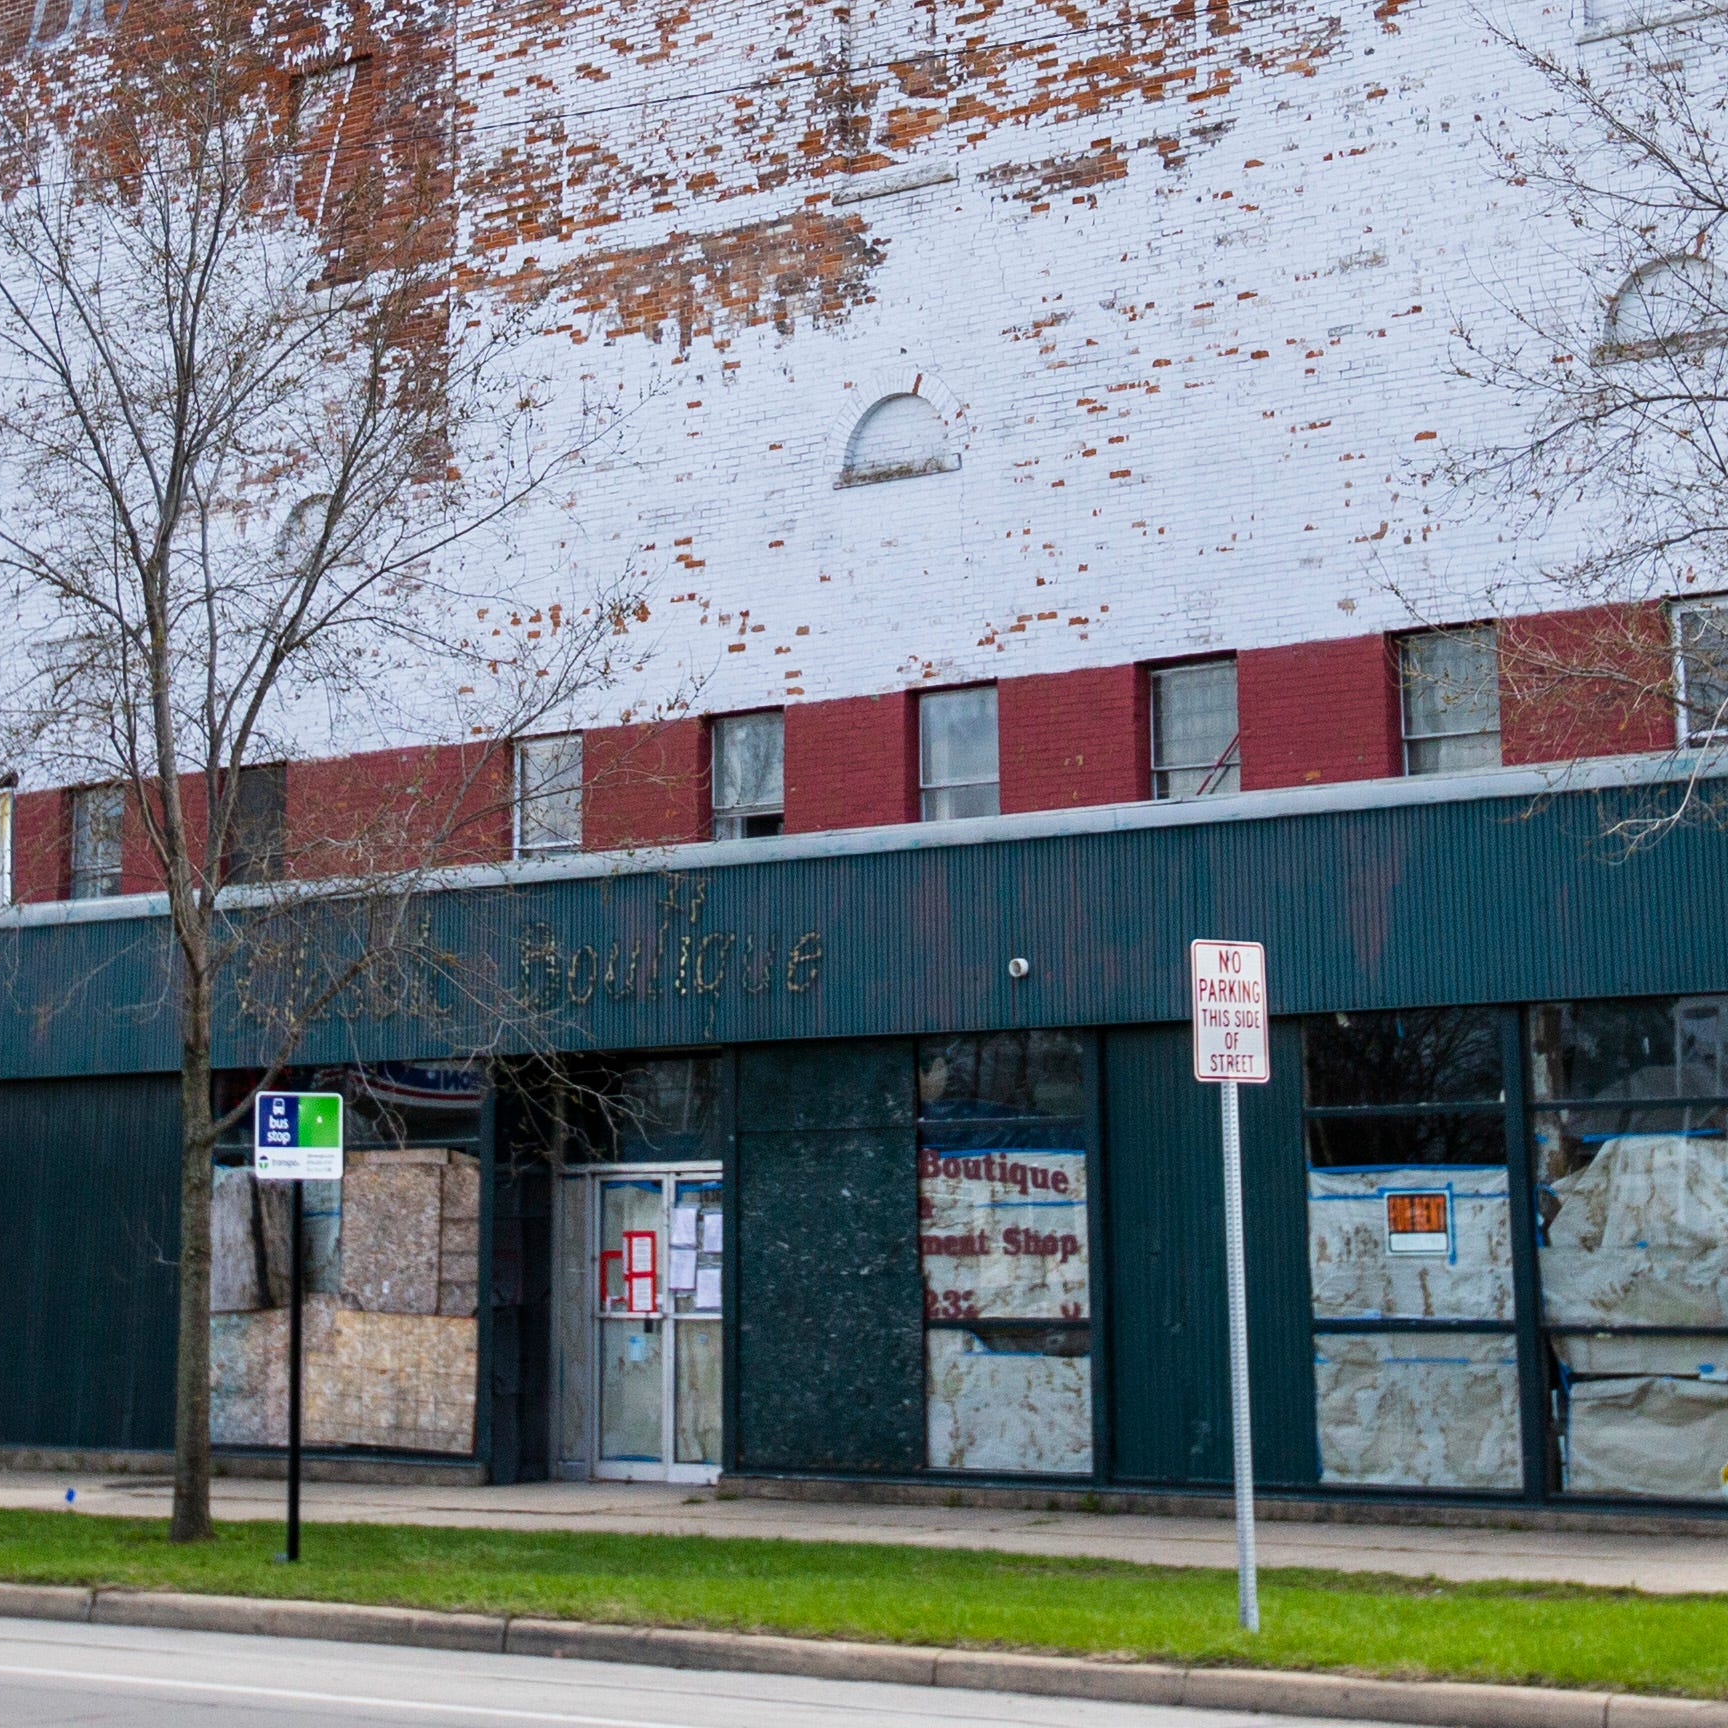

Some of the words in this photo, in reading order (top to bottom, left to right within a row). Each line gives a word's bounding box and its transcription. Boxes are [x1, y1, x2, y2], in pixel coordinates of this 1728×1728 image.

[520, 872, 824, 1040] Boutique
[1218, 950, 1242, 974] NO
[1199, 978, 1261, 1004] PARKING
[1201, 1009, 1230, 1027] THIS
[1234, 1010, 1260, 1029] SIDE
[1224, 1032, 1240, 1050] OF
[1210, 1054, 1255, 1073] STREET
[269, 1116, 289, 1128] bus
[267, 1131, 290, 1145] stop
[918, 1148, 1069, 1196] Boutique
[1002, 1226, 1079, 1264] Shop
